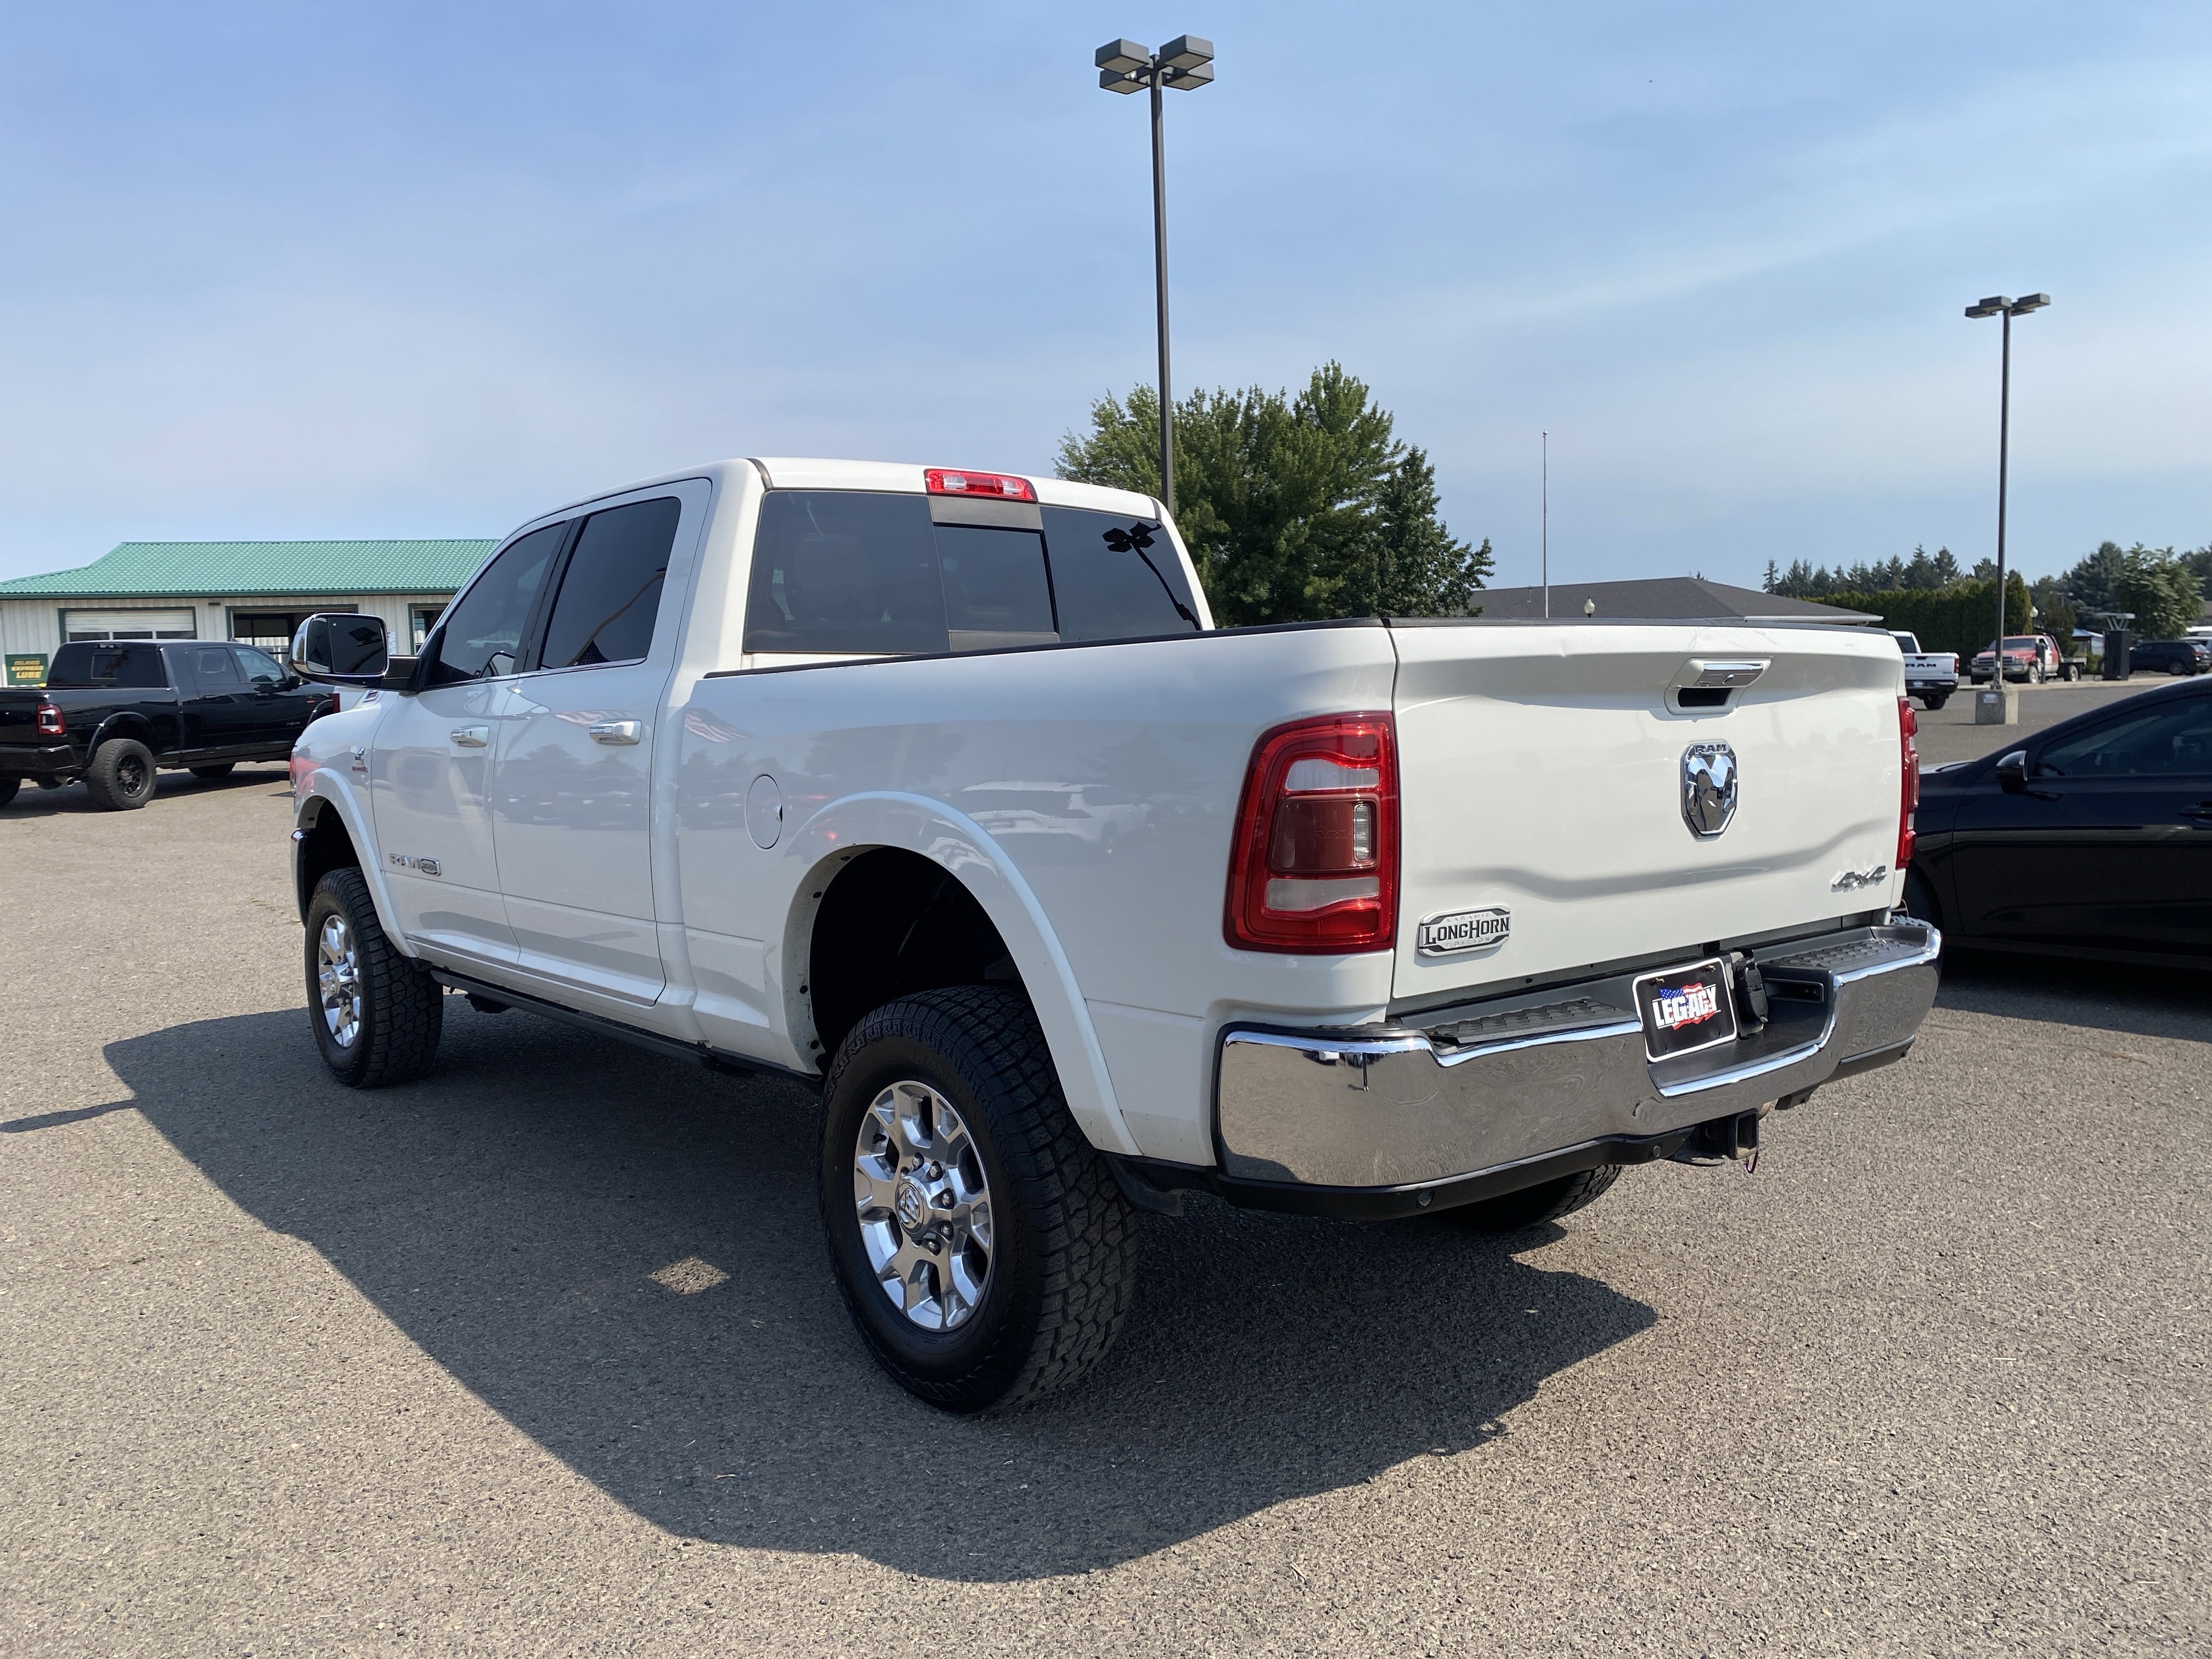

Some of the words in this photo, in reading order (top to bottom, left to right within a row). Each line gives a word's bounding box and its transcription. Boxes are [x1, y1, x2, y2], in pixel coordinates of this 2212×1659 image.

[1694, 744, 1727, 754] RAM
[1447, 912, 1491, 923] LARAMIE
[1446, 937, 1491, 947] EDITION
[1652, 985, 1717, 1028] LEGACY
